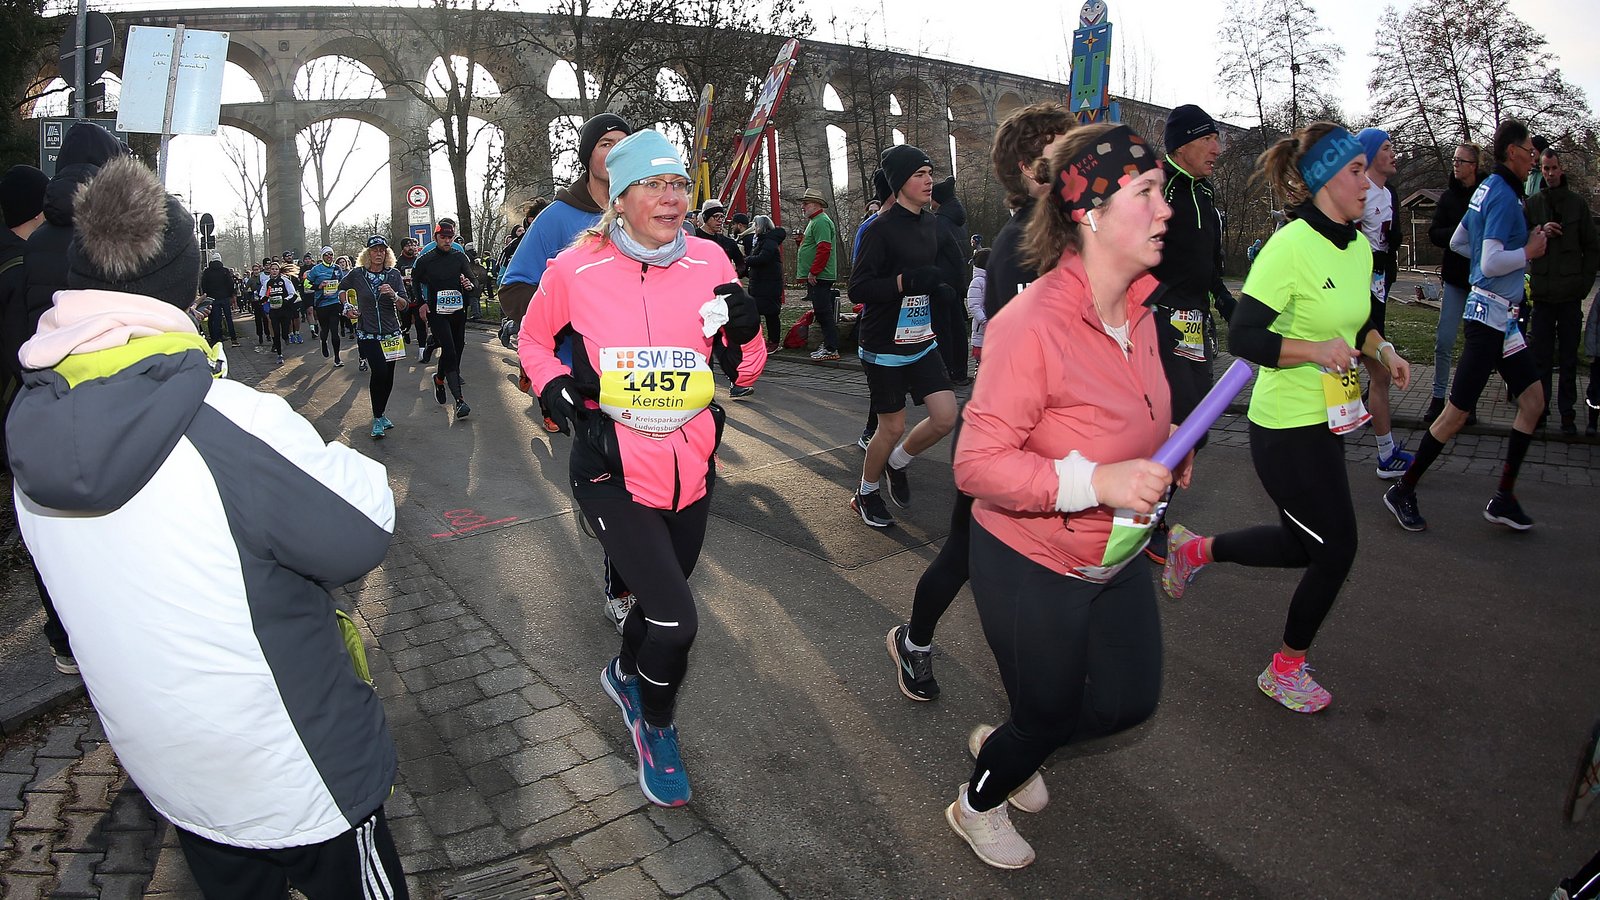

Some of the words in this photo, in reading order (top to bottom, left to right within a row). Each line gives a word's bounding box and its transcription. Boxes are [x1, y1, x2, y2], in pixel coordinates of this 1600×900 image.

[48, 154, 58, 162] Par
[439, 296, 462, 305] 3893
[623, 371, 691, 392] 1457
[632, 394, 684, 408] Kerstin
